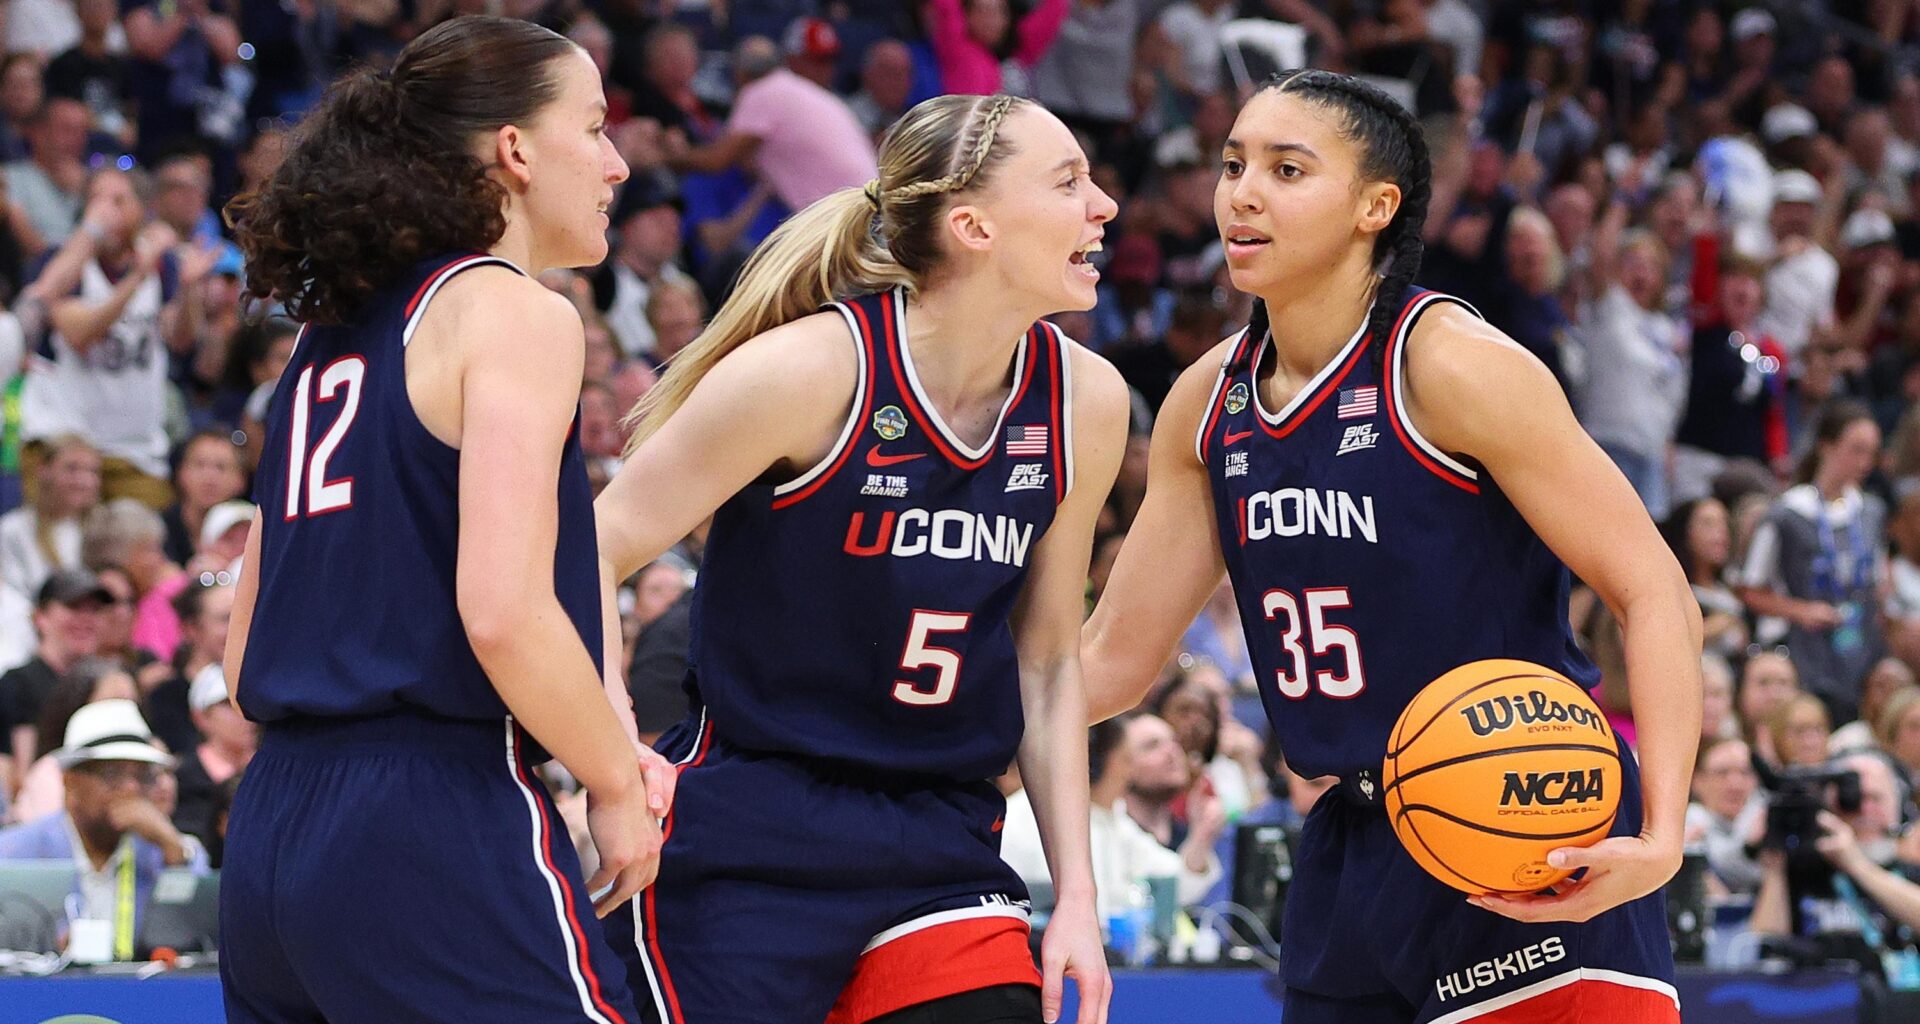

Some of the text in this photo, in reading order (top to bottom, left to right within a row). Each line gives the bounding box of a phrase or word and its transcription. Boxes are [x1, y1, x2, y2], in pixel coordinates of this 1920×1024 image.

[284, 353, 368, 522] 12
[1343, 423, 1373, 438] BIG
[1339, 432, 1380, 449] EAST
[1230, 451, 1248, 465] THE
[1011, 463, 1043, 476] BIG
[867, 474, 907, 487] BE THE
[1007, 474, 1049, 486] EAST
[860, 485, 909, 497] CHANGE
[843, 508, 1034, 567] UCONN
[1262, 586, 1366, 700] 35
[891, 608, 974, 708] 5
[1460, 690, 1607, 737] Wilson
[1527, 725, 1550, 733] EVO
[1499, 767, 1603, 806] NCAA
[1436, 936, 1566, 1002] HUSKIES
